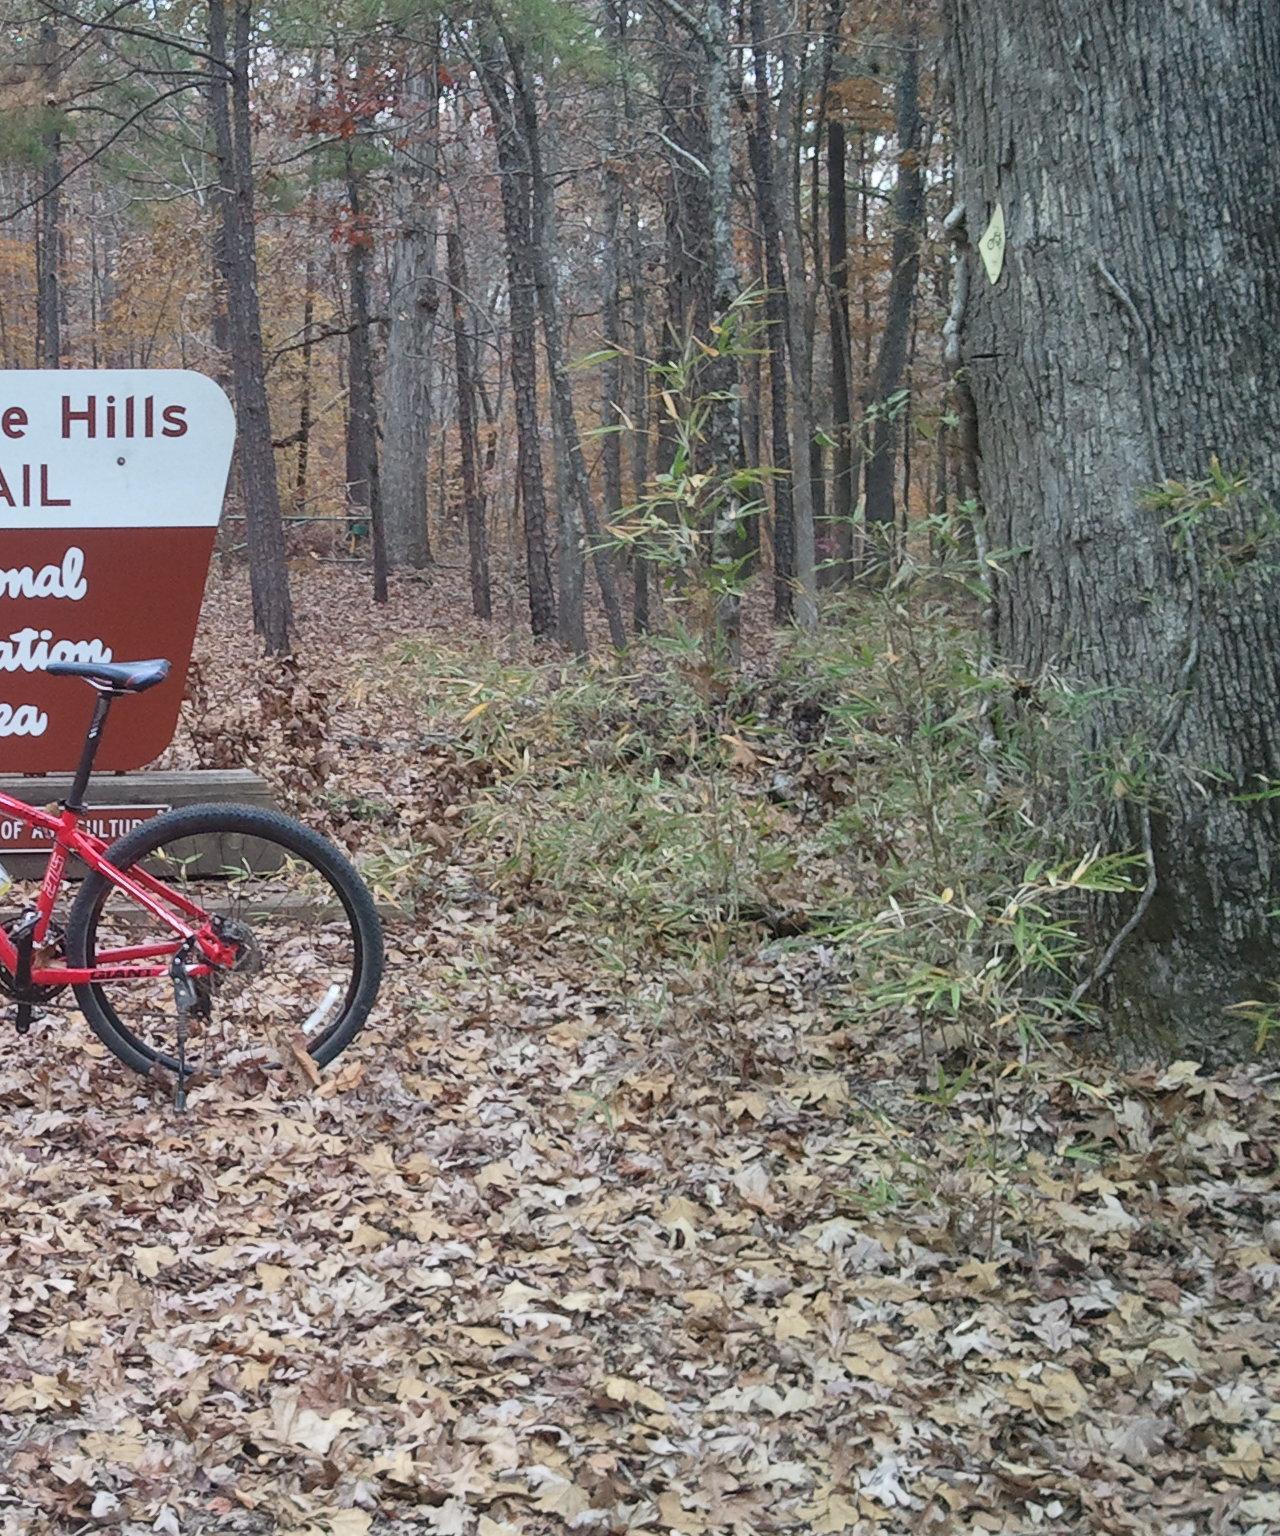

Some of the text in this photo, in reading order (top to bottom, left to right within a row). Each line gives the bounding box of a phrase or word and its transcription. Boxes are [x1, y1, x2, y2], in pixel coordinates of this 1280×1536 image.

[61, 394, 188, 438] Hills
[1, 820, 24, 840] OF
[90, 968, 152, 980] GIANT
